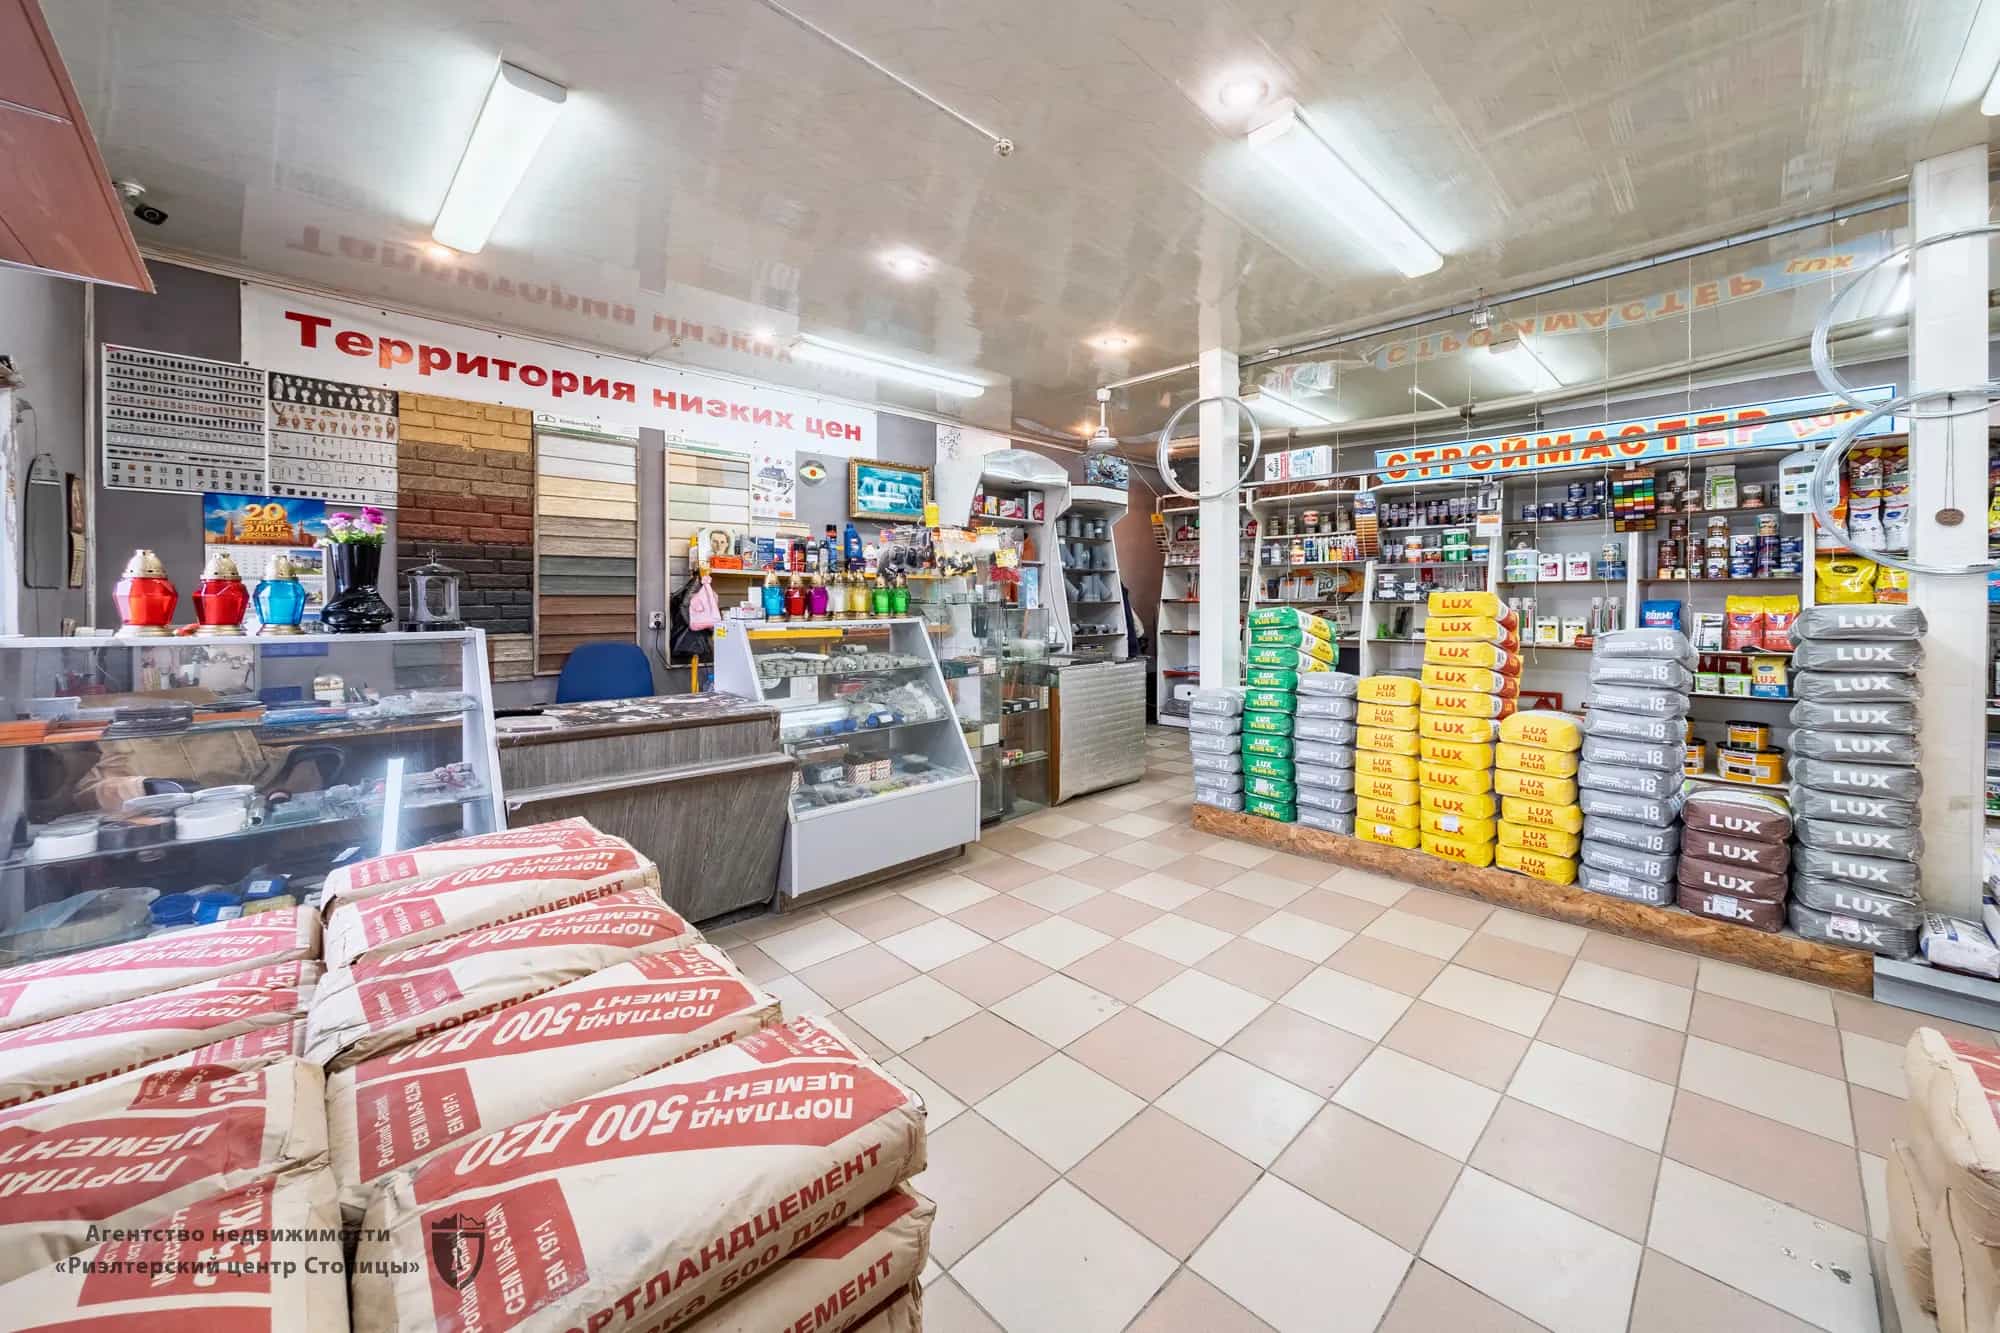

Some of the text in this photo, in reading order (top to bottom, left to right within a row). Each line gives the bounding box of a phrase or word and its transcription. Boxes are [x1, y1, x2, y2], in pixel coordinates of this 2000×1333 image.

[285, 311, 636, 402] Территория
[653, 388, 795, 430] низких
[805, 416, 862, 441] цен
[1386, 410, 1768, 479] СТРОЙМАСТЕР
[1442, 599, 1473, 609] LUX
[1441, 622, 1472, 632] LUX
[1838, 614, 1897, 628] LUX
[1659, 636, 1674, 650] 18
[1438, 647, 1469, 658] LUX
[1836, 647, 1896, 661] LUX
[1435, 672, 1467, 682] LUX
[1651, 666, 1668, 680] 18
[1377, 684, 1396, 692] LUX
[1834, 676, 1894, 692] LUX
[1376, 690, 1396, 698] PLUS
[1435, 697, 1467, 708] LUX
[1649, 697, 1666, 712] 18
[1374, 715, 1394, 723] PLUS
[1375, 708, 1394, 716] LUX
[1832, 708, 1892, 725] LUX
[1434, 722, 1465, 734] LUX
[1522, 725, 1548, 736] LUX
[1648, 724, 1666, 738] 18
[1374, 733, 1394, 741] LUX
[1522, 734, 1548, 744] PLUS
[1374, 740, 1394, 749] PLUS
[1834, 738, 1893, 754] LUX
[1431, 747, 1463, 760] LUX
[1520, 752, 1545, 762] LUX
[1646, 750, 1664, 764] 18
[1373, 758, 1392, 766] LUX
[1520, 761, 1546, 770] PLUS
[1372, 766, 1392, 774] PLUS
[1428, 772, 1459, 785] LUX
[1520, 778, 1544, 789] LUX
[1640, 778, 1657, 793] 18
[1832, 770, 1891, 790] LUX
[1373, 782, 1392, 790] LUX
[1520, 788, 1544, 797] PLUS
[1372, 790, 1393, 798] PLUS
[1376, 805, 1396, 814] LUX
[1433, 797, 1464, 812] LUX
[1830, 799, 1889, 819] LUX
[1376, 814, 1396, 822] PLUS
[1528, 806, 1553, 818] LUX
[1642, 806, 1660, 820] 18
[1528, 816, 1554, 825] PLUS
[1709, 814, 1762, 835] LUX
[1523, 830, 1547, 841] LUX
[1834, 830, 1894, 850] LUX
[1522, 839, 1548, 849] PLUS
[1646, 836, 1664, 851] 18
[1435, 844, 1465, 858] LUX
[1708, 841, 1760, 864] LUX
[519, 852, 616, 866] ЦЕМЕНТ
[1521, 856, 1545, 868] LUX
[511, 862, 609, 876] ПОРТЛАНД
[1520, 865, 1546, 876] PLUS
[1643, 860, 1661, 876] 18
[1831, 860, 1890, 883] LUX
[1704, 871, 1756, 894] LUX
[1640, 886, 1658, 901] 18
[1834, 894, 1893, 918] LUX
[550, 911, 660, 926] ЦЕМЕНТ
[538, 923, 654, 938] ПОРТЛАНД
[586, 987, 721, 1012] ЦЕМЕНТ
[491, 1001, 582, 1046] 500
[576, 1003, 716, 1032] ПОРТЛАНД
[696, 1072, 854, 1105] ЦЕМЕНТ
[688, 1098, 854, 1130] ПОРТЛАНД
[454, 1094, 689, 1176] 500 Д20
[533, 1218, 568, 1291] EN 197-1
[718, 1245, 780, 1293] 500
[500, 1268, 526, 1316] CEM
